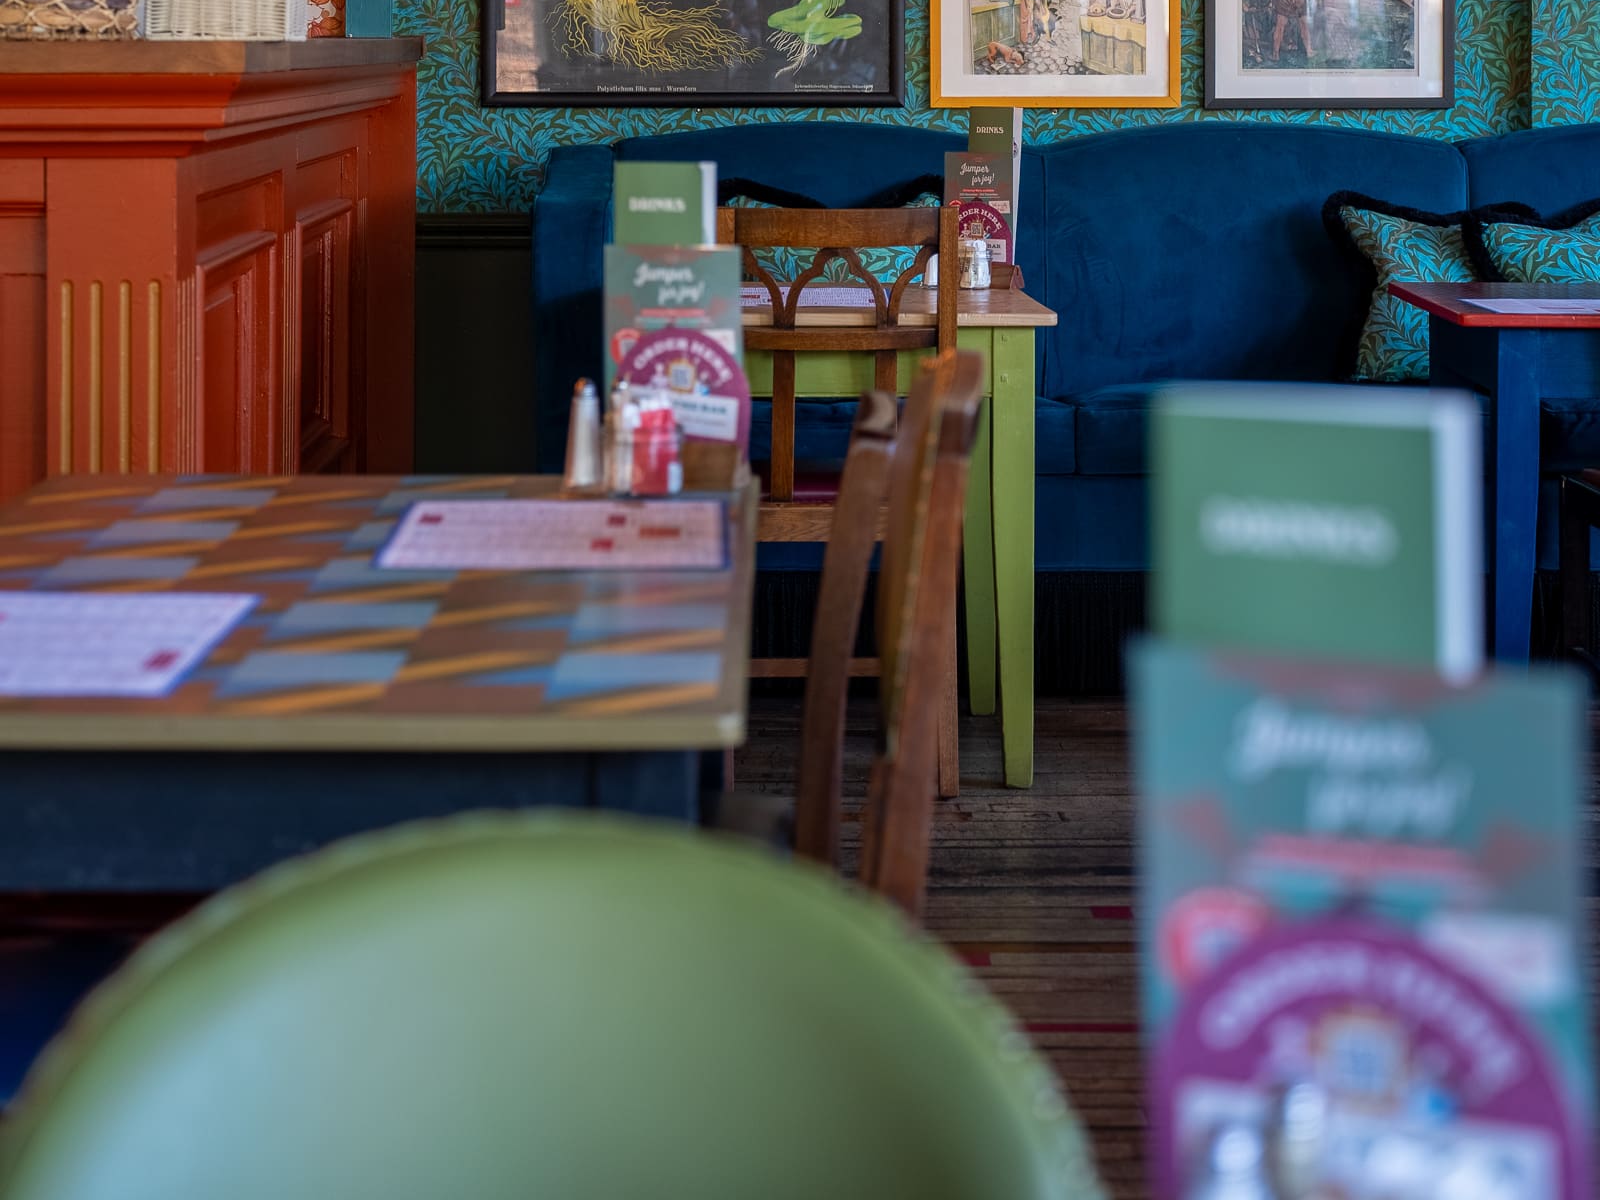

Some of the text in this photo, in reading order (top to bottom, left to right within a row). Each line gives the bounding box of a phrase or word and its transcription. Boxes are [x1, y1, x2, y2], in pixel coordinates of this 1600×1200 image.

[976, 126, 1004, 134] DRINKS
[960, 163, 989, 176] Jumper
[971, 173, 995, 186] for joy!
[958, 207, 980, 221] RDER
[981, 208, 1003, 229] HERE
